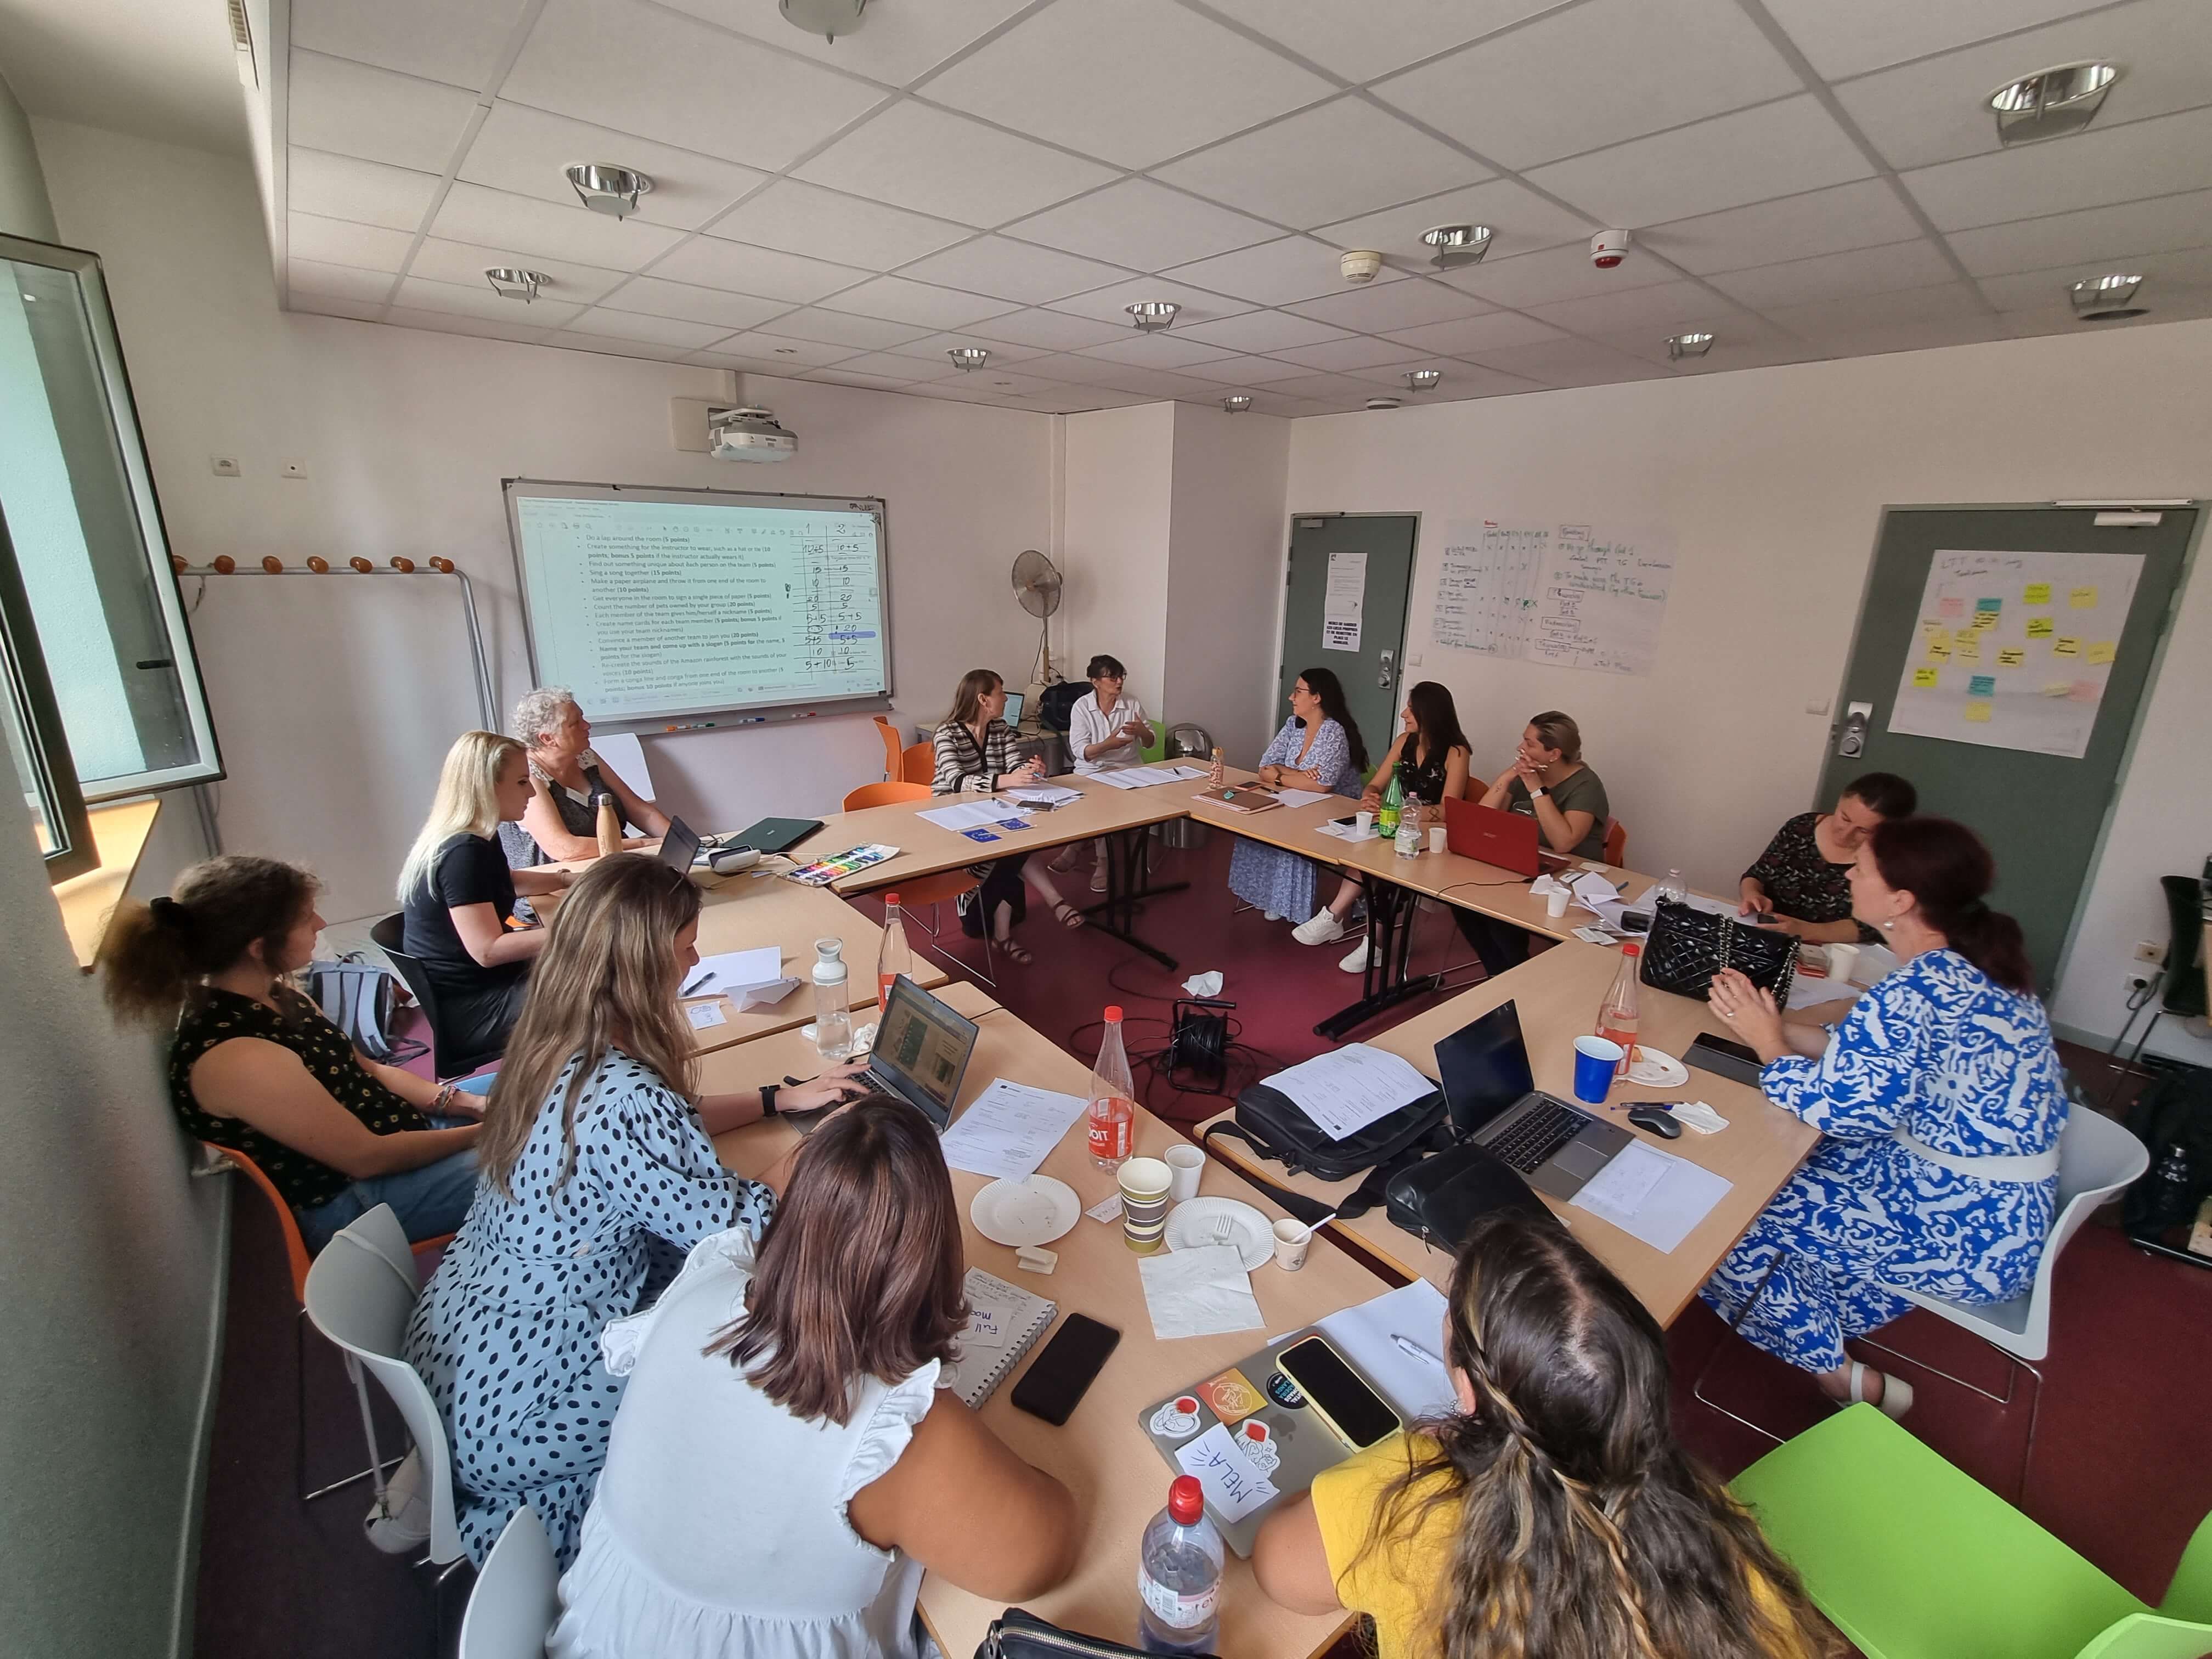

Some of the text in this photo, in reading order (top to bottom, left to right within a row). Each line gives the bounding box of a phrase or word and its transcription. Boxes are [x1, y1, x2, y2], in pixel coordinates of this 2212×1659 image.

[836, 523, 846, 534] 2
[843, 577, 850, 585] 10
[844, 657, 855, 670] 5
[1088, 1129, 1108, 1141] OIT
[970, 1310, 992, 1321] Moo
[974, 1323, 998, 1335] Full
[1275, 1380, 1291, 1395] LANDS
[1278, 1384, 1295, 1399] ADEIRA
[1284, 1386, 1300, 1402] OMADS
[1290, 1392, 1303, 1403] ITAL
[1209, 1452, 1253, 1504] MELA
